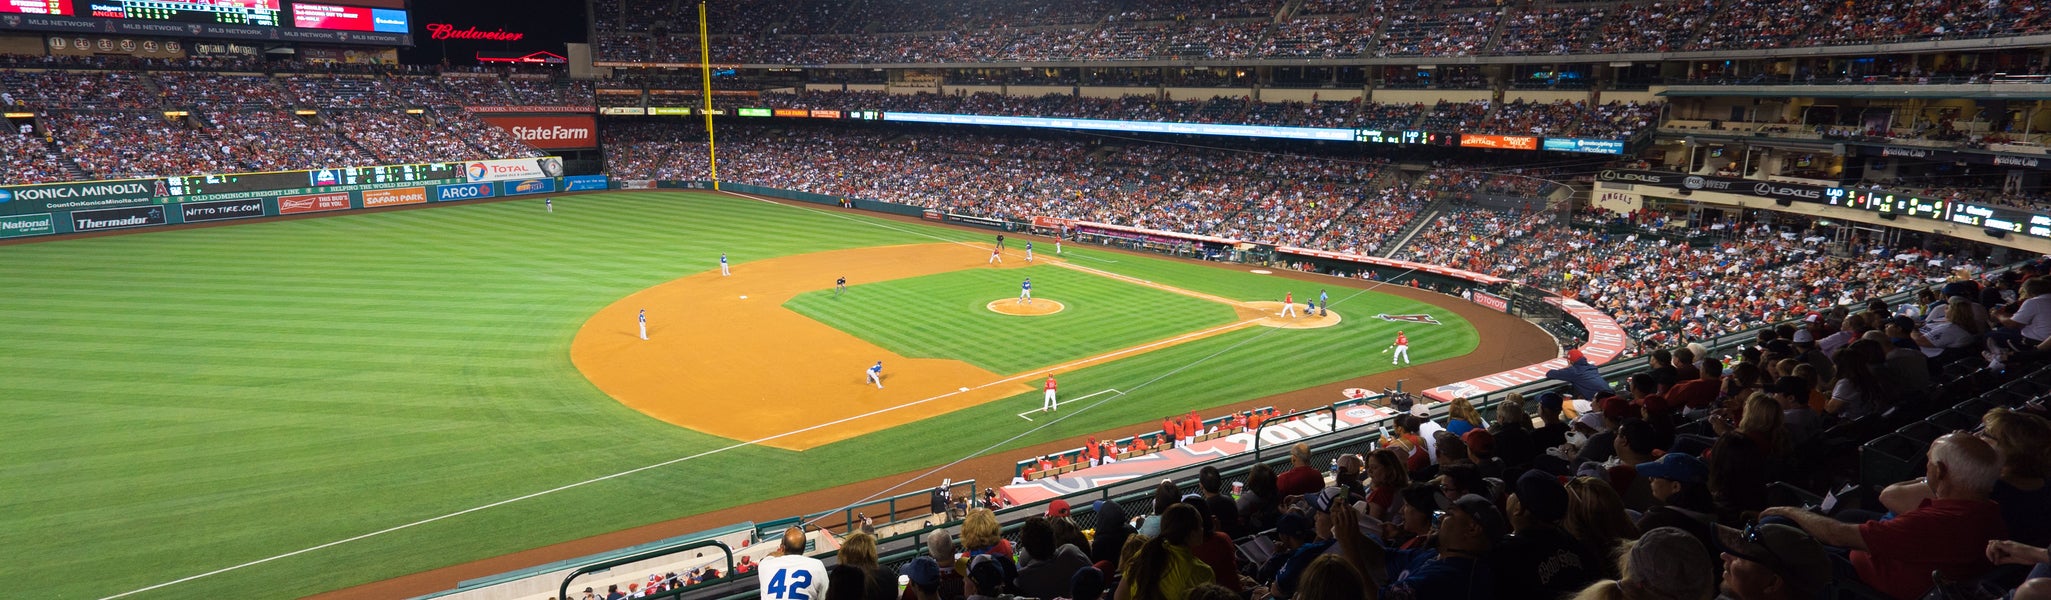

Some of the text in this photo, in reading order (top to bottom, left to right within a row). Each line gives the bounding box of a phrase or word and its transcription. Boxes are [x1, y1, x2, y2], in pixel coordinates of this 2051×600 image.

[50, 20, 95, 28] NETWORK
[143, 24, 183, 32] NETWORK
[226, 28, 262, 36] NETWORK
[426, 24, 524, 41] Budweiser
[195, 43, 258, 56] Captain Morgan
[1461, 139, 1497, 147] HERITAGE
[491, 165, 528, 174] TOTAL
[412, 179, 442, 187] PROMISES
[1616, 173, 1661, 183] LEXUS
[1705, 180, 1731, 190] WEST
[14, 183, 148, 201] KONICA MINOLTA
[209, 192, 250, 200] DOMINION
[251, 190, 283, 198] FREIGHT
[441, 186, 478, 199] ARCO
[1601, 192, 1632, 205] ANGELS
[1771, 186, 1820, 199] LEXUS
[1826, 188, 1865, 204] LAD 1 6
[46, 197, 149, 209] CountOnKonicaMinolta.com
[367, 195, 399, 205] SAFARI
[400, 194, 424, 202] PARK
[1846, 199, 1854, 208] 4
[1885, 195, 1893, 203] 6
[1897, 200, 1906, 209] E
[1934, 201, 1943, 210] 6
[186, 203, 260, 217] NITTO TIRE.COM
[1880, 204, 1891, 212] 11
[1933, 210, 1941, 219] 7
[2, 219, 49, 230] National
[76, 215, 148, 230] Thermador
[1482, 296, 1507, 313] TOYOTA
[1226, 411, 1351, 451] 2016
[768, 568, 812, 599] 42
